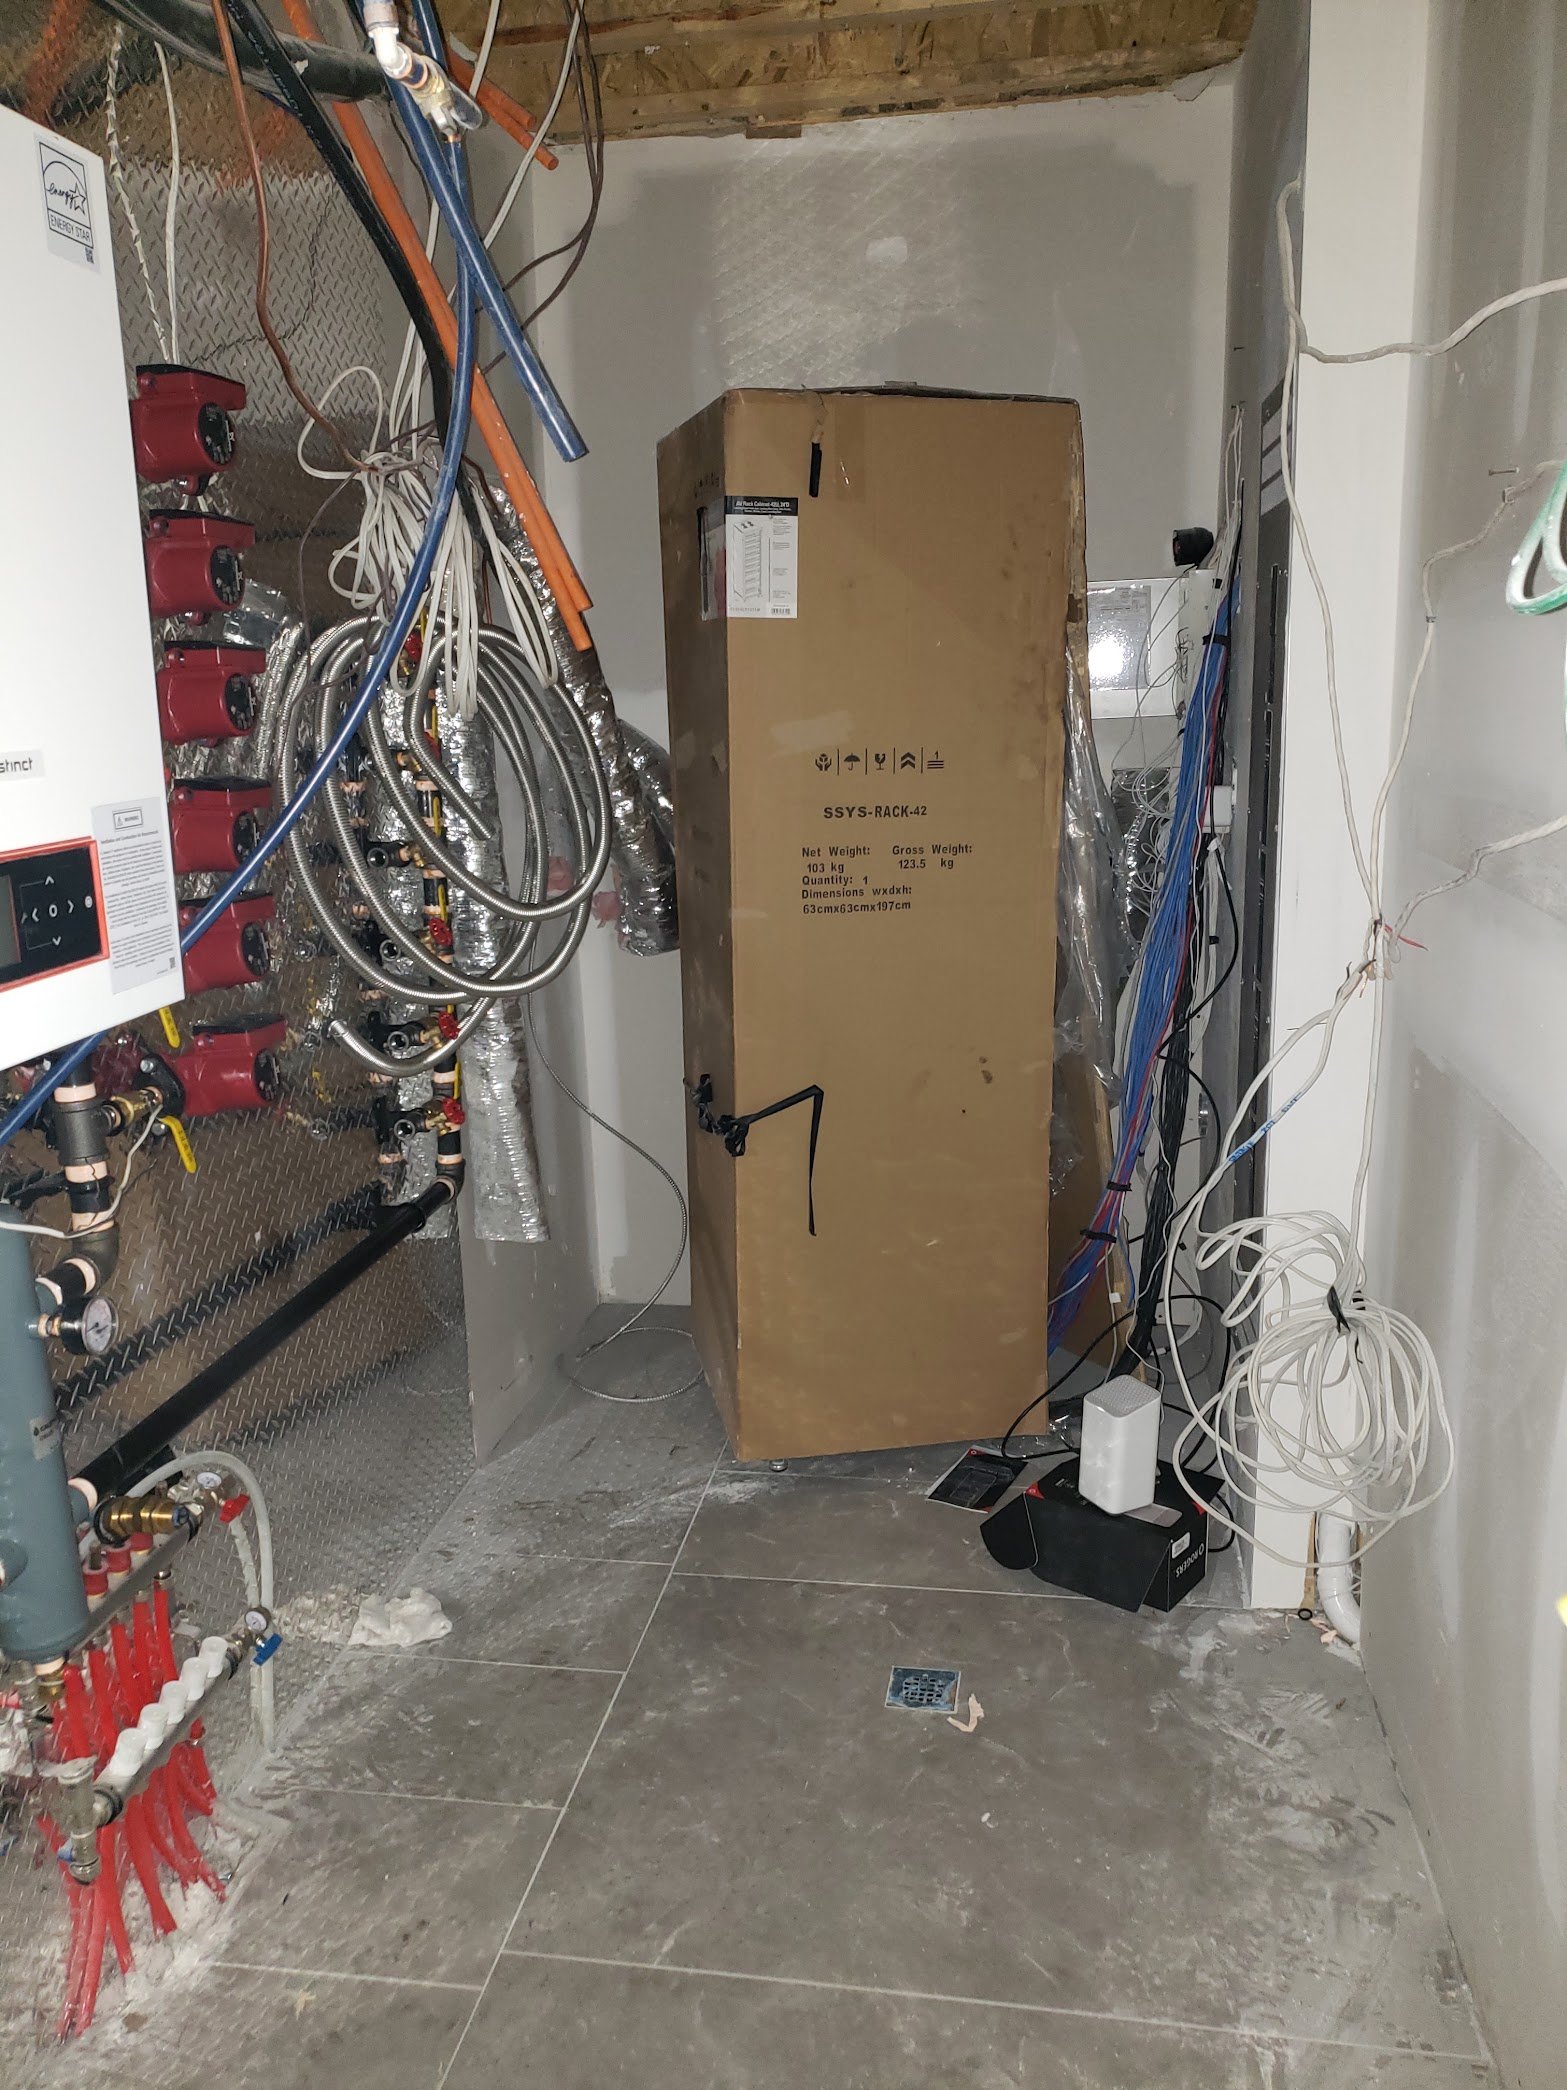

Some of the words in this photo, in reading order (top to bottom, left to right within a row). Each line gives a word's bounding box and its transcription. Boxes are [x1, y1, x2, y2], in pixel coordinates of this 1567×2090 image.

[50, 214, 74, 235] ENERGY
[75, 226, 91, 243] STAR
[823, 805, 928, 819] SSYS-RACK-42
[802, 847, 821, 858] Net
[829, 845, 870, 858] Weight:
[892, 845, 924, 856] Gross
[931, 843, 972, 857] Weight:
[807, 862, 825, 873] 103
[830, 862, 845, 874] kg
[898, 858, 926, 869] 123.5
[940, 857, 954, 869] kg
[802, 875, 853, 887] Quantity:
[862, 876, 869, 885] 1
[801, 887, 865, 899] Dimensions
[872, 885, 912, 897] wxdxh:
[803, 901, 911, 914] 63cmx63cmx197cm
[1175, 1549, 1199, 1578] ROGERS
